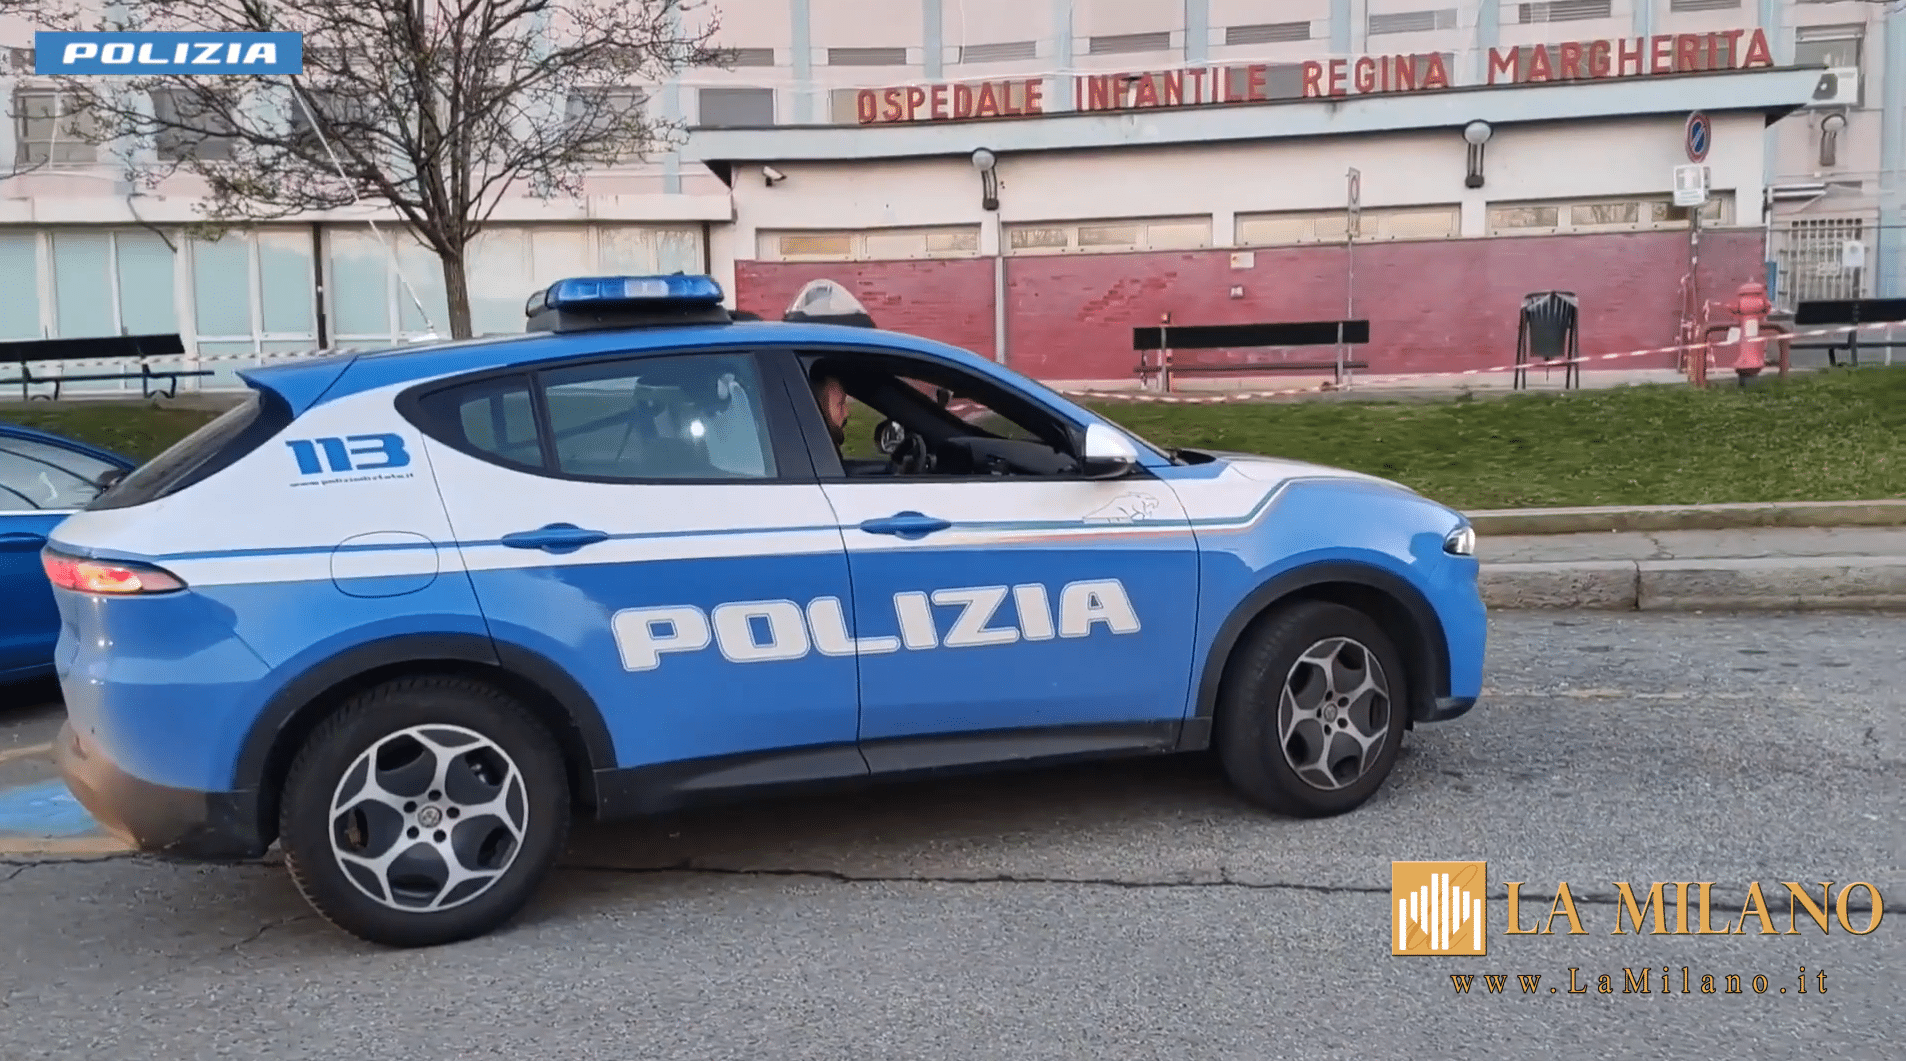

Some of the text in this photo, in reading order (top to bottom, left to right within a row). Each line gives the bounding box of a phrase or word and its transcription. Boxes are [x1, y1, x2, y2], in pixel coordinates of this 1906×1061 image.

[857, 27, 1774, 125] OSPEDALE INFANTILE REGINA MARGHERITA
[285, 432, 411, 475] 113
[611, 578, 1141, 672] POLIZIA
